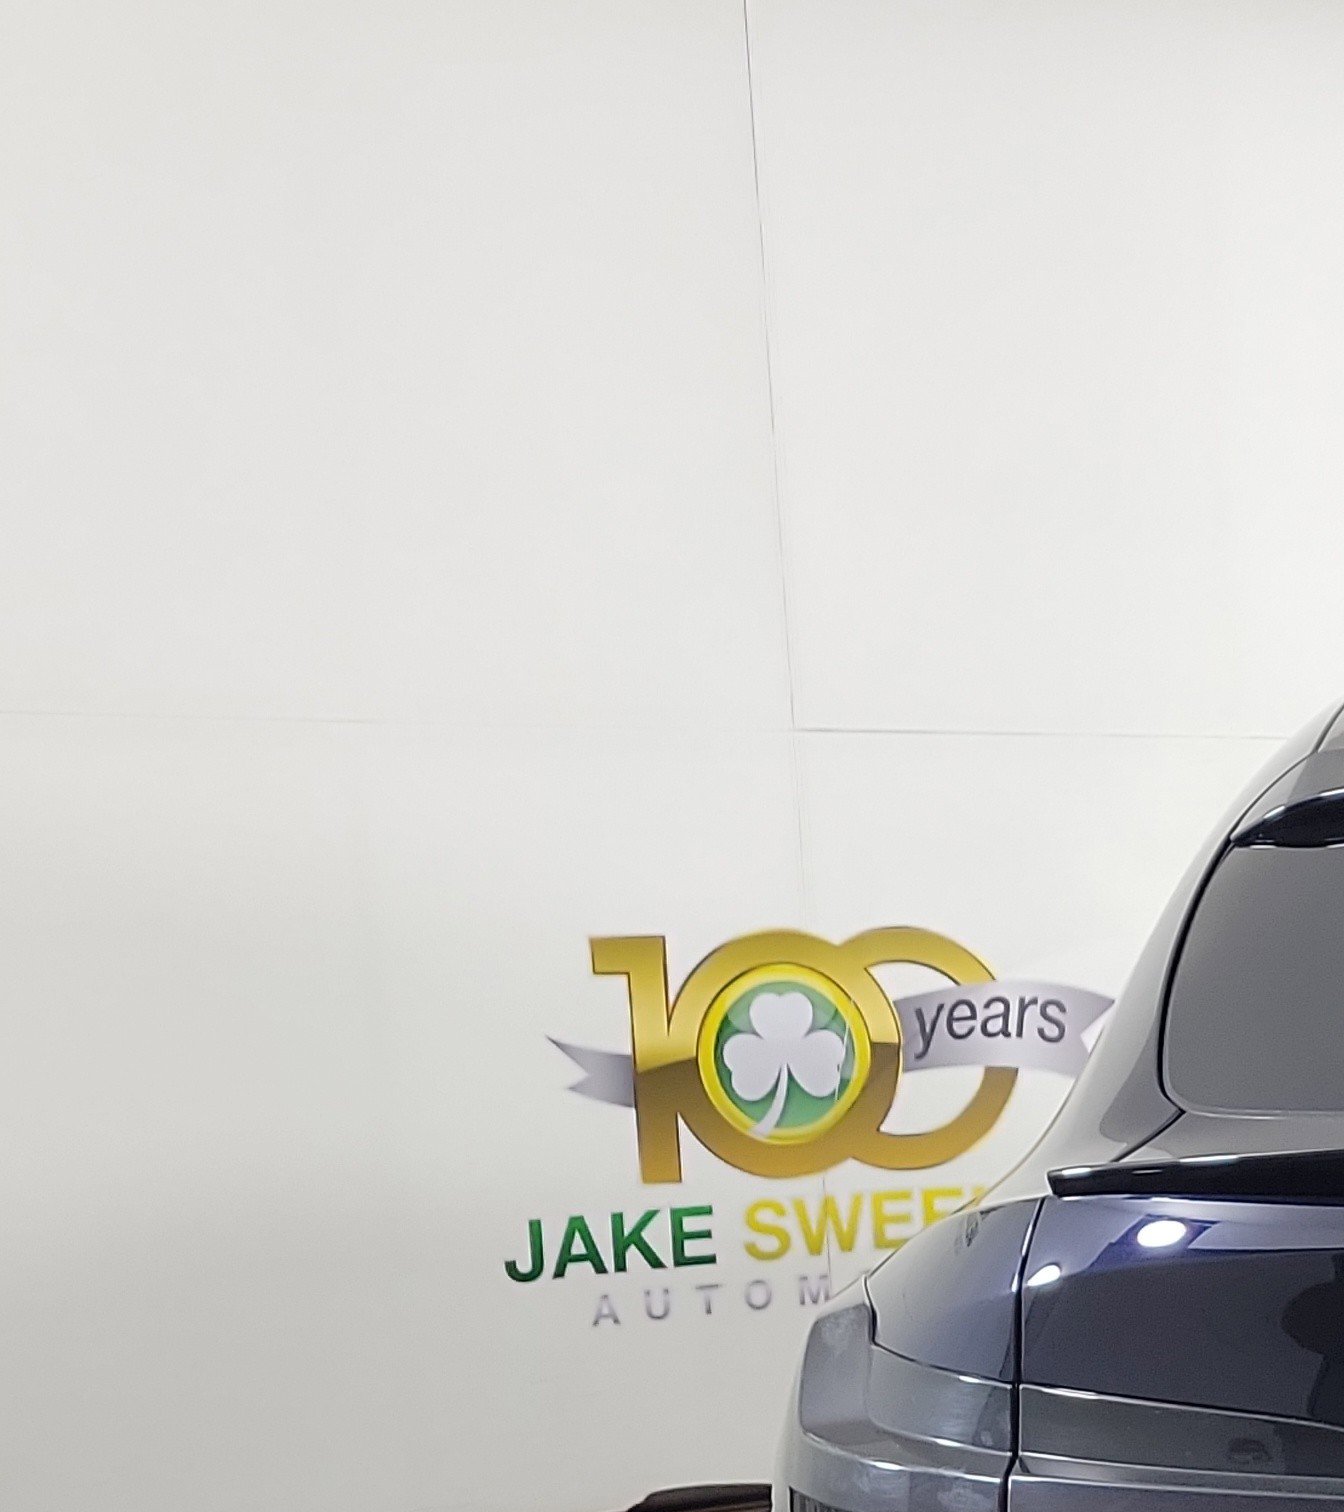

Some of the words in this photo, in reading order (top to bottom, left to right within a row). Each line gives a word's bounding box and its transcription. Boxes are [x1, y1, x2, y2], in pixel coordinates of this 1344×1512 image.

[588, 926, 1018, 1183] 100
[913, 994, 1068, 1060] years
[503, 1204, 718, 1283] JAKE
[591, 1274, 832, 1328] AUTOM
